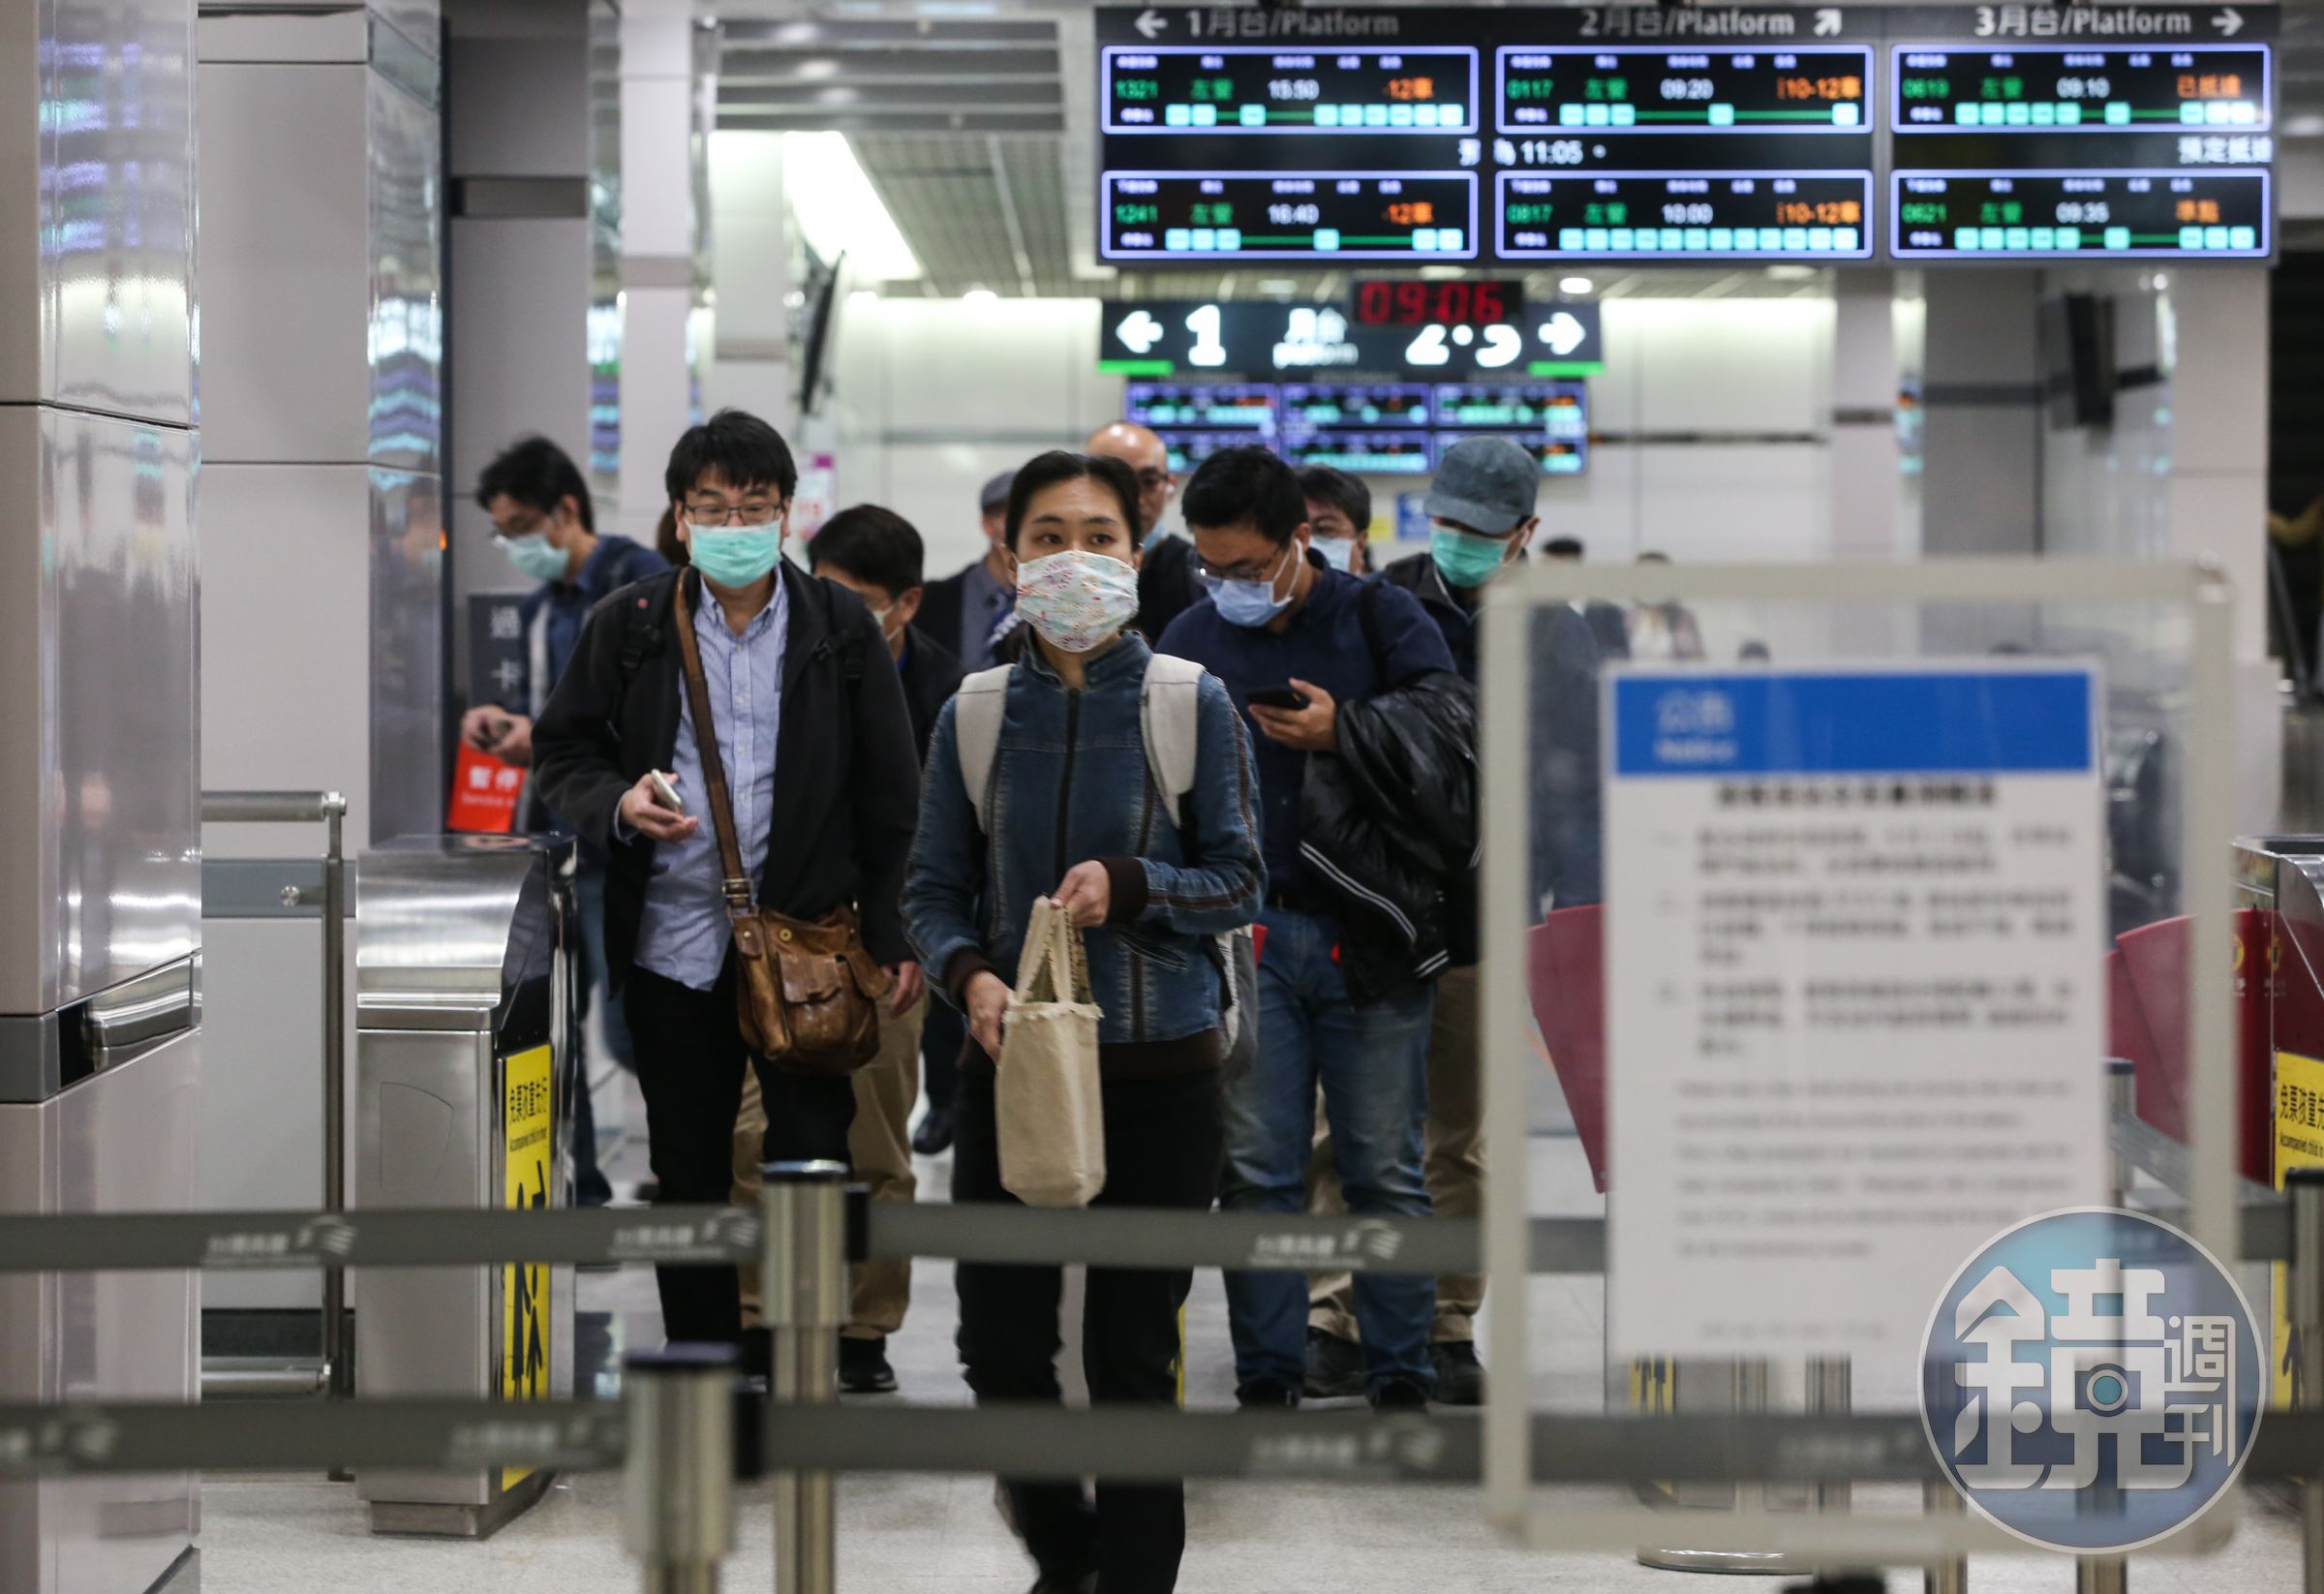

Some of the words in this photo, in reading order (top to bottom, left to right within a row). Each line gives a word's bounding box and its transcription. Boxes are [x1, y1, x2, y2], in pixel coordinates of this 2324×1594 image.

[1974, 8, 2191, 36] 3月台/Platform
[1520, 139, 1584, 165] 11:05
[1360, 280, 1503, 325] 09:06
[1186, 304, 1226, 367] 1
